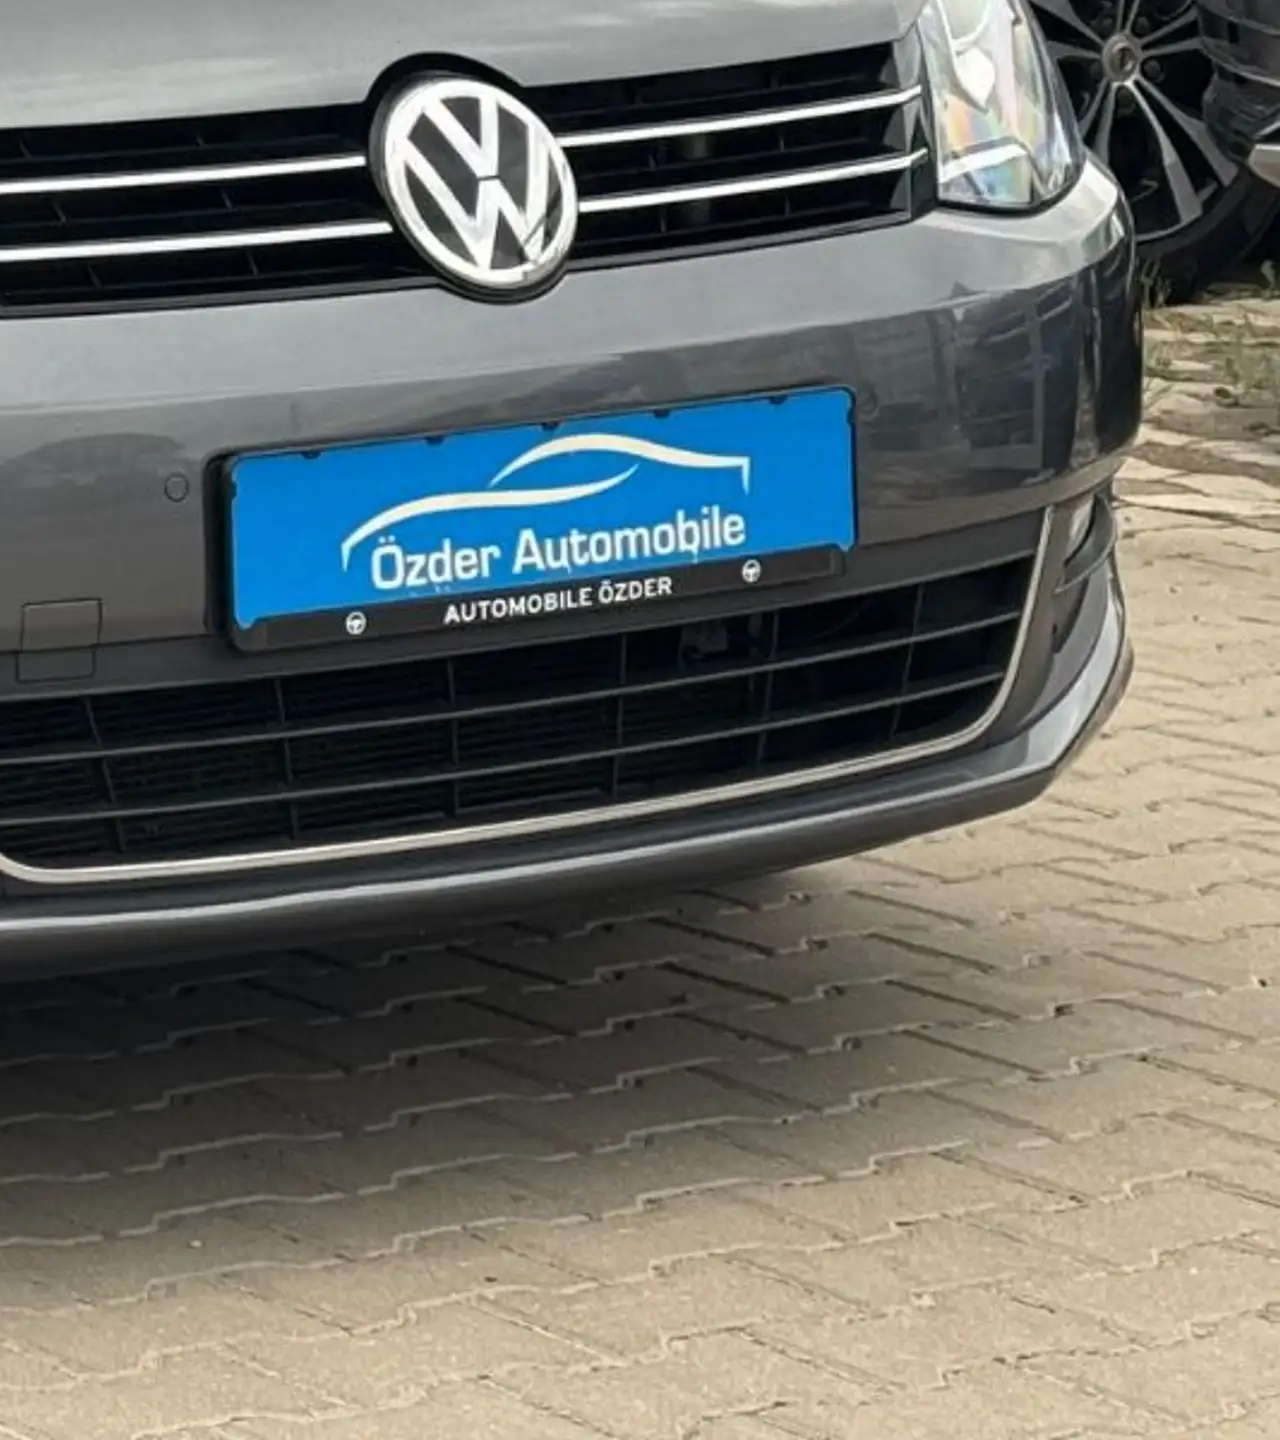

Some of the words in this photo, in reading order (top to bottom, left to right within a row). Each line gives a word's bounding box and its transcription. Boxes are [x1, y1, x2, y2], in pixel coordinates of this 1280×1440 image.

[388, 83, 576, 284] VW
[370, 535, 502, 590] Özder
[512, 504, 747, 575] Automobile
[443, 586, 594, 626] AUTOMOBILE
[598, 576, 673, 604] ÖZDER
